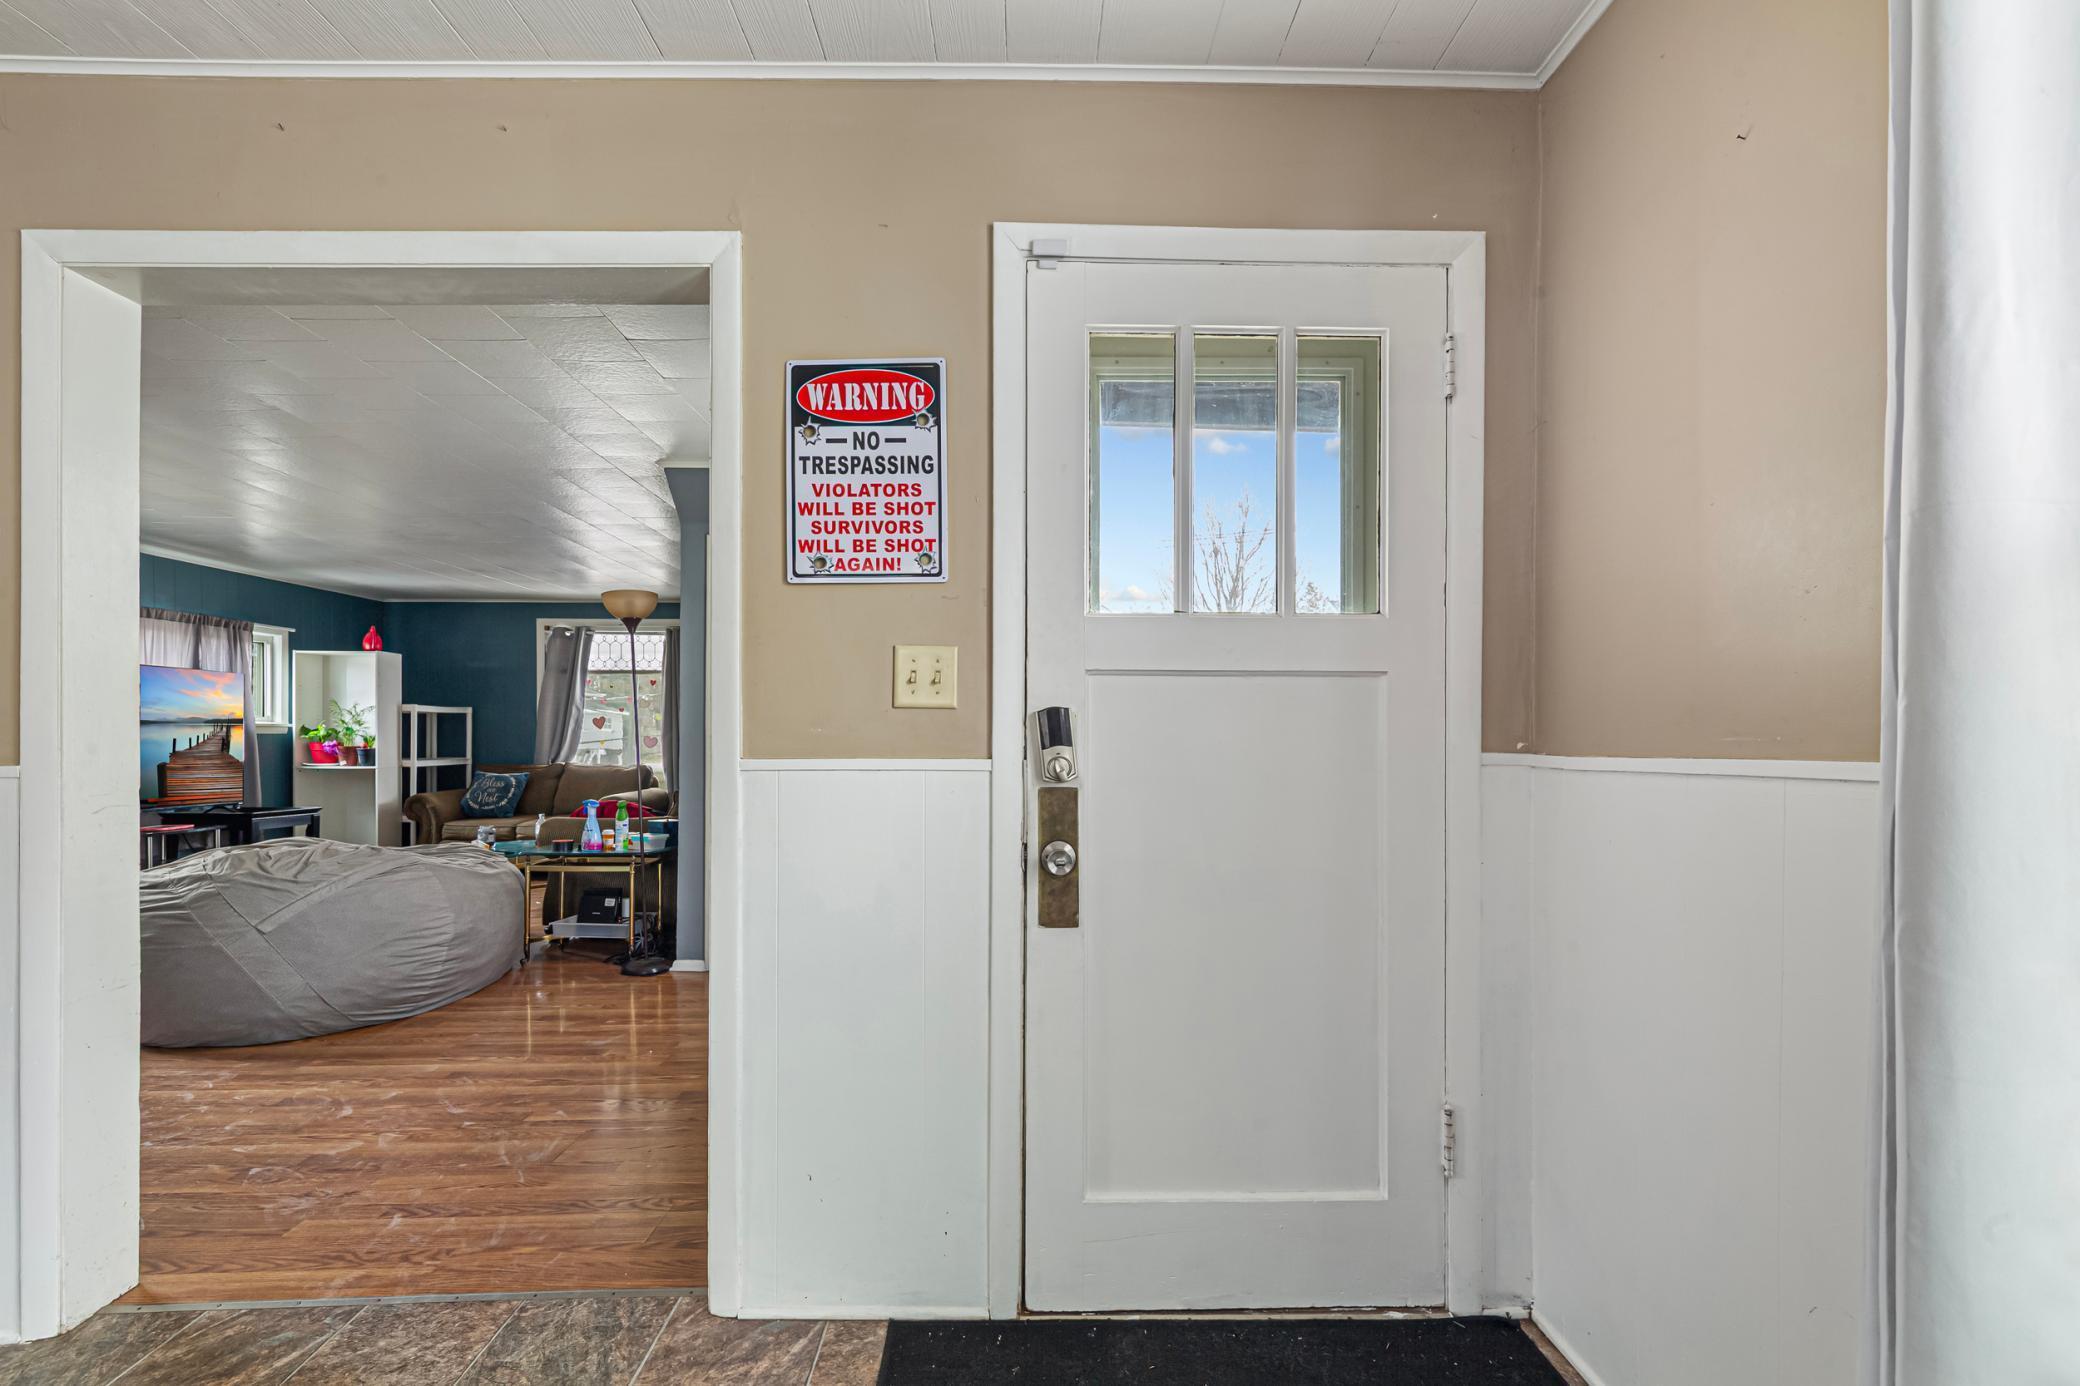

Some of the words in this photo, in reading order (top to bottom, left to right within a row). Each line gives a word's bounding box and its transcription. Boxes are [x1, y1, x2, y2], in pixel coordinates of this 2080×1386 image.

[807, 381, 925, 411] WARNING
[853, 431, 880, 450] NO
[799, 455, 934, 475] TRESPASSING
[812, 483, 922, 497] VIOLATORS
[798, 502, 844, 516] WILL
[852, 502, 876, 516] BE
[884, 501, 936, 516] SHOT
[811, 520, 924, 534] SURVIVORS
[798, 539, 845, 553] WILL
[852, 539, 877, 553] BE
[884, 538, 936, 553] SHOT
[834, 557, 901, 571] AGAIN!
[482, 778, 505, 788] Bless
